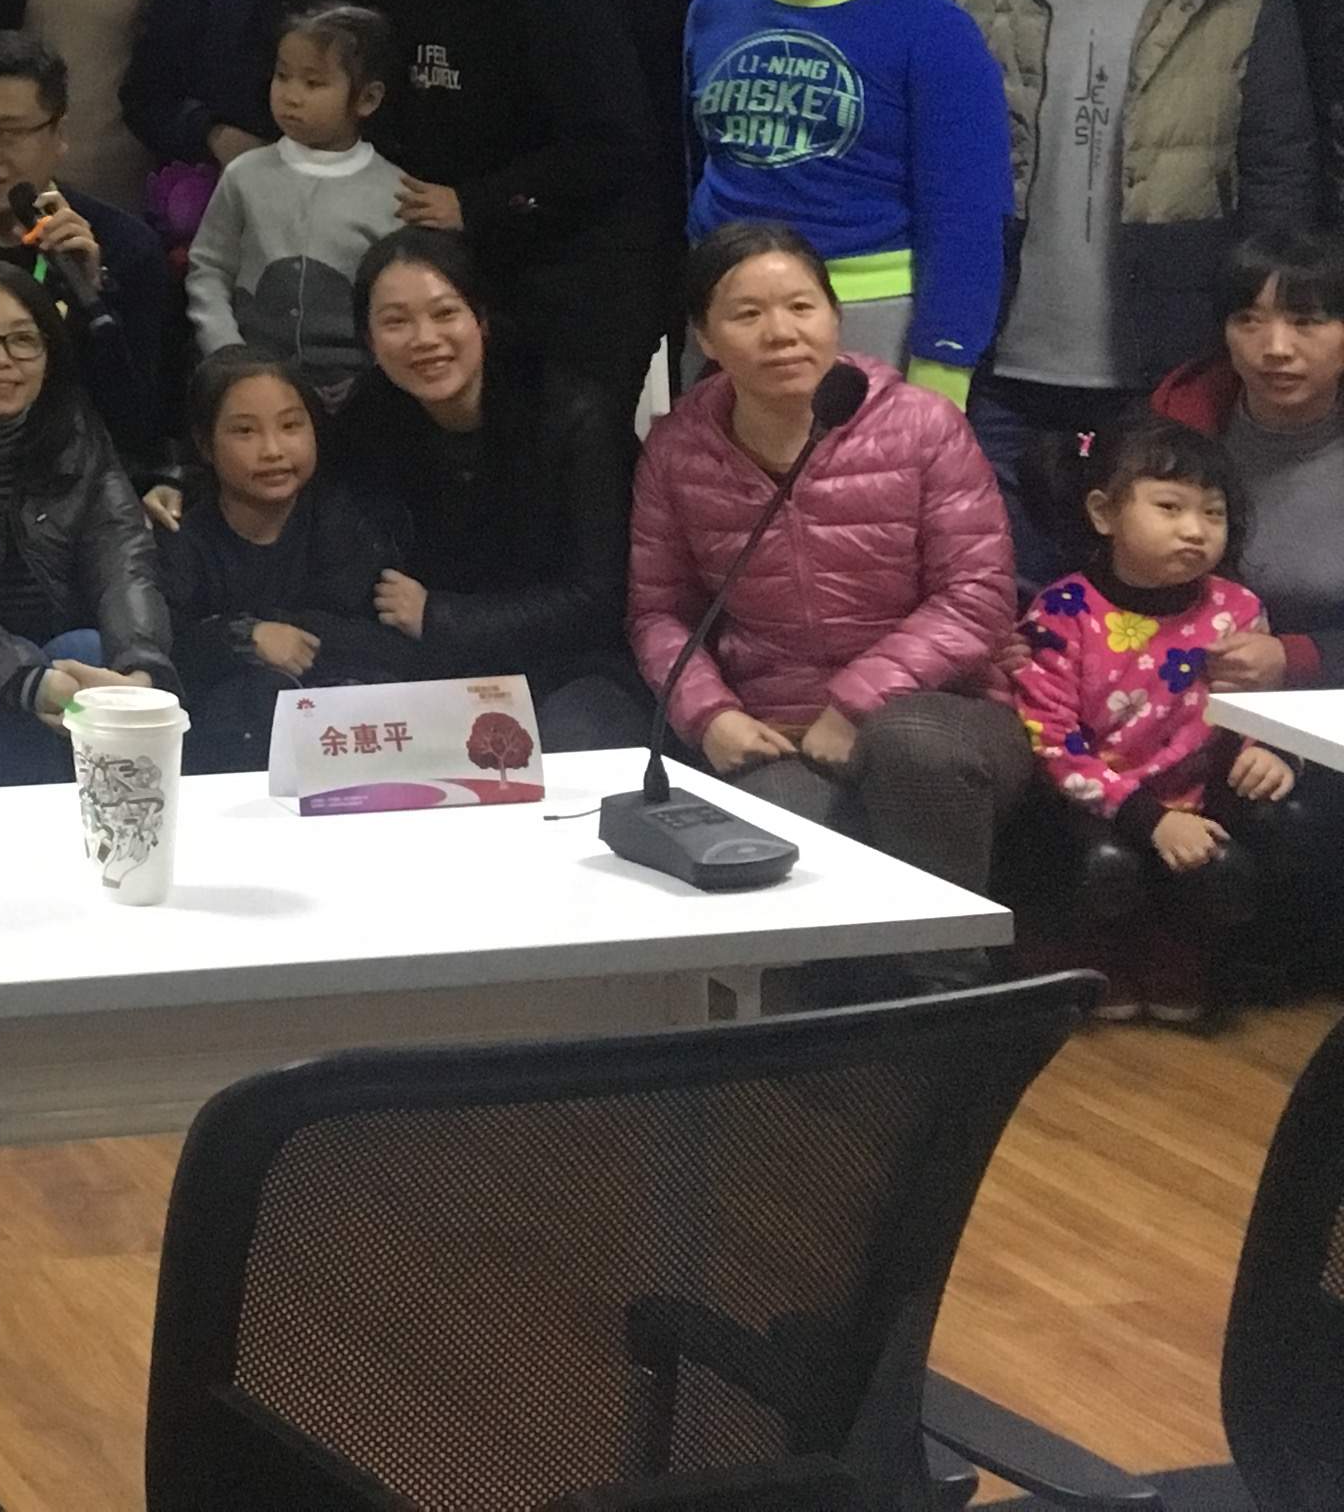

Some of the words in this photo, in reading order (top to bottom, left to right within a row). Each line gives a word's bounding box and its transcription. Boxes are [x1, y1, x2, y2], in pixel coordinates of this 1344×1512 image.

[737, 54, 831, 81] LI-NING
[700, 78, 860, 128] BASKET
[721, 114, 814, 154] BALL
[319, 721, 413, 756] 余惠平
